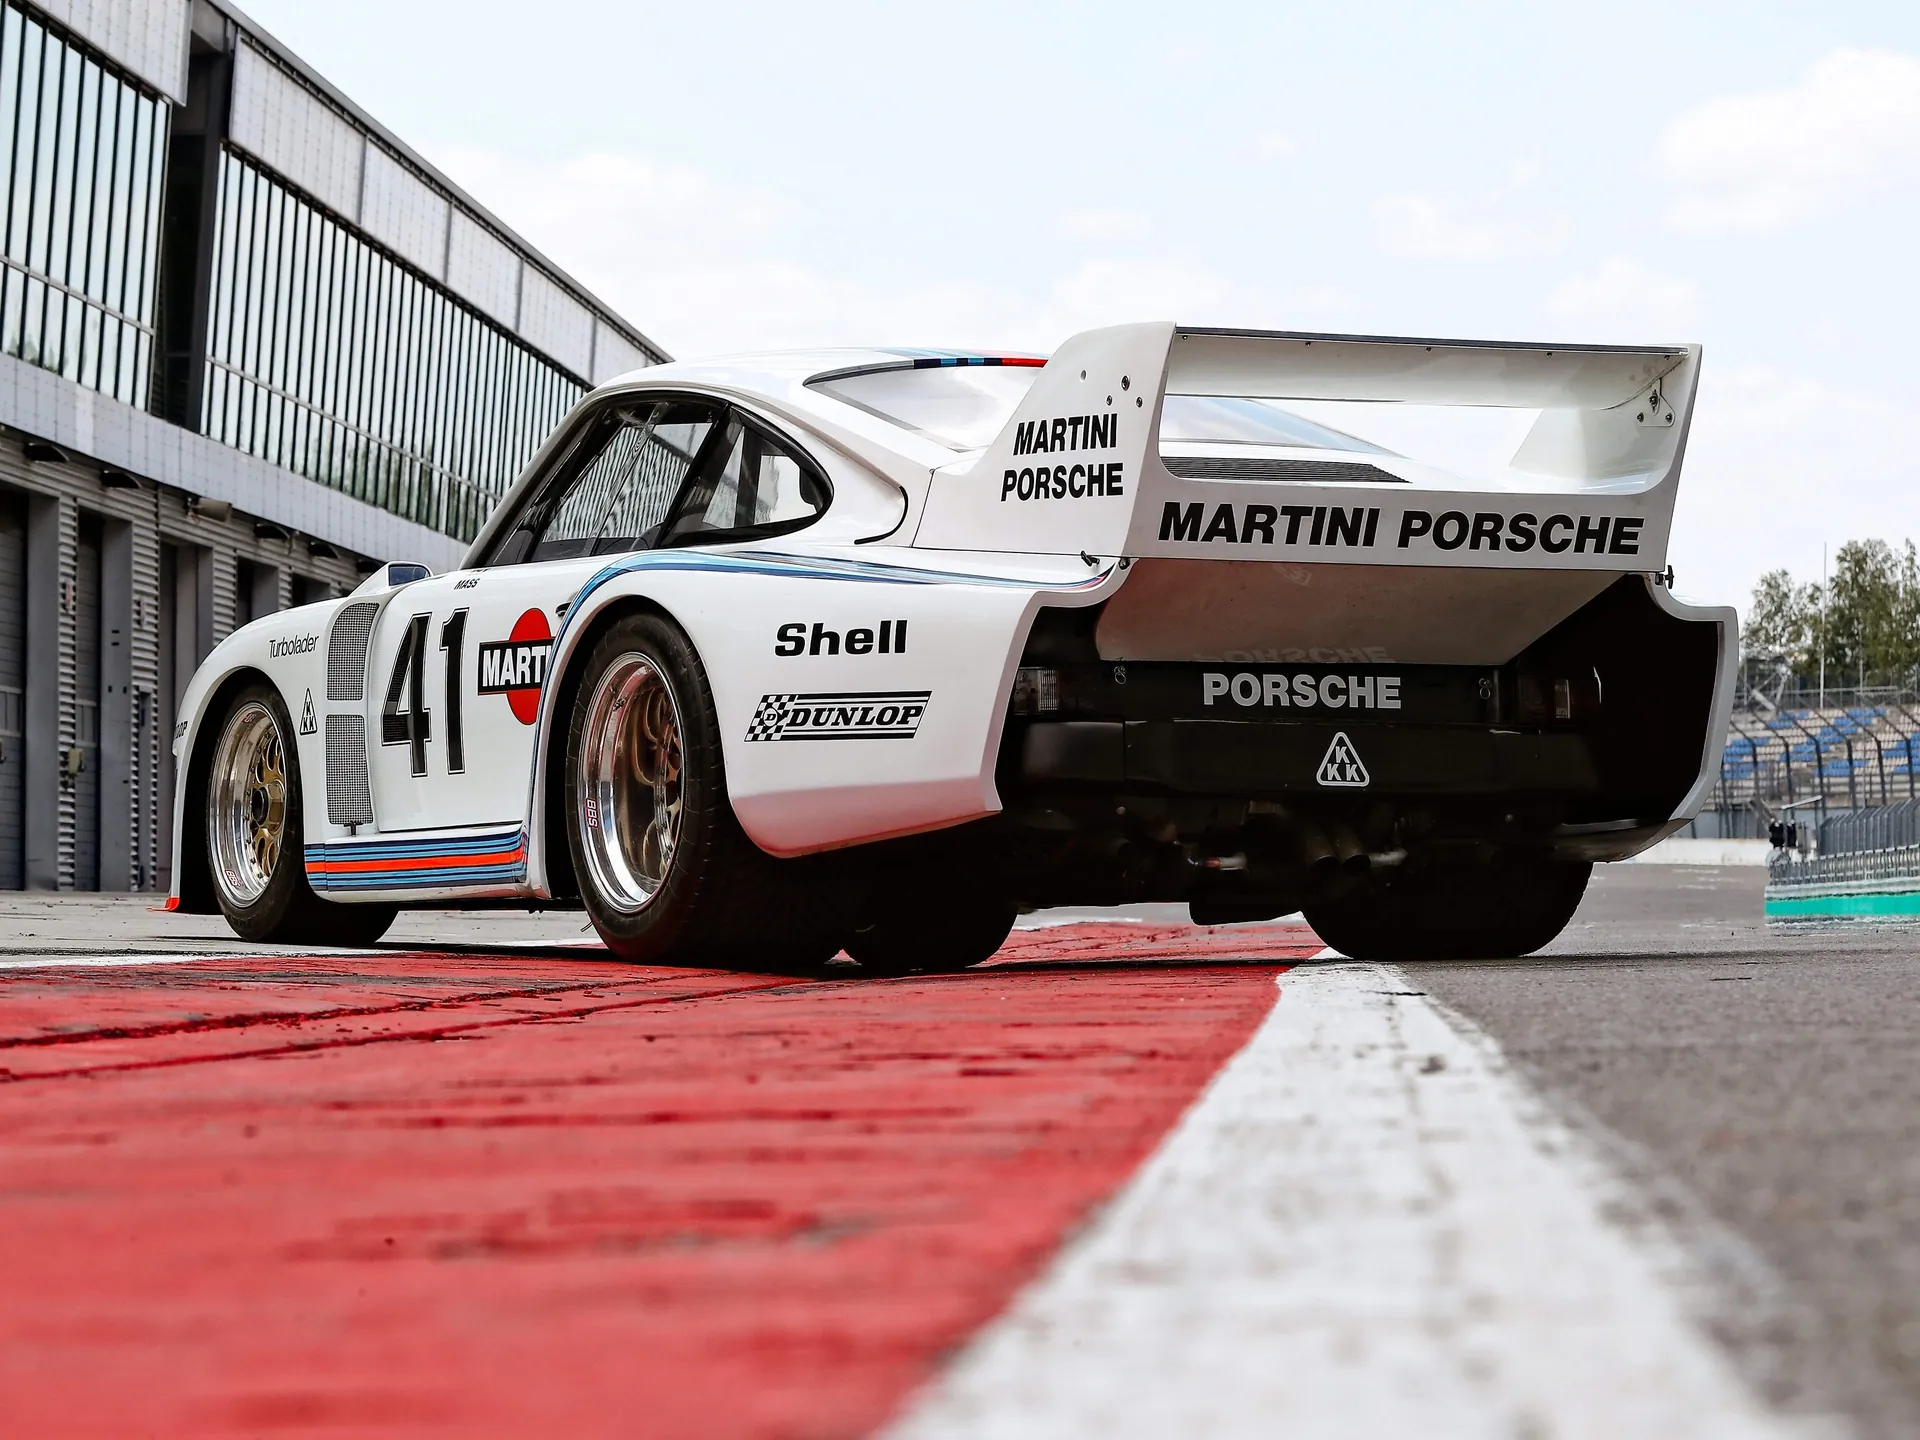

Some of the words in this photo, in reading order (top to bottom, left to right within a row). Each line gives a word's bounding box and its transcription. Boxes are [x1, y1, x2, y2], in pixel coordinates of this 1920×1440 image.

[1013, 413, 1117, 456] MARTINI
[1001, 463, 1124, 502] PORSCHE
[1158, 501, 1380, 548] MARTINI
[1397, 510, 1645, 555] PORSCHE
[453, 578, 480, 590] MASS
[269, 633, 319, 658] Turbolader
[774, 620, 908, 657] Shell
[380, 607, 470, 778] 41
[1203, 673, 1401, 709] PORSCHE
[785, 705, 924, 727] DUNLOP
[586, 799, 598, 828] BBS
